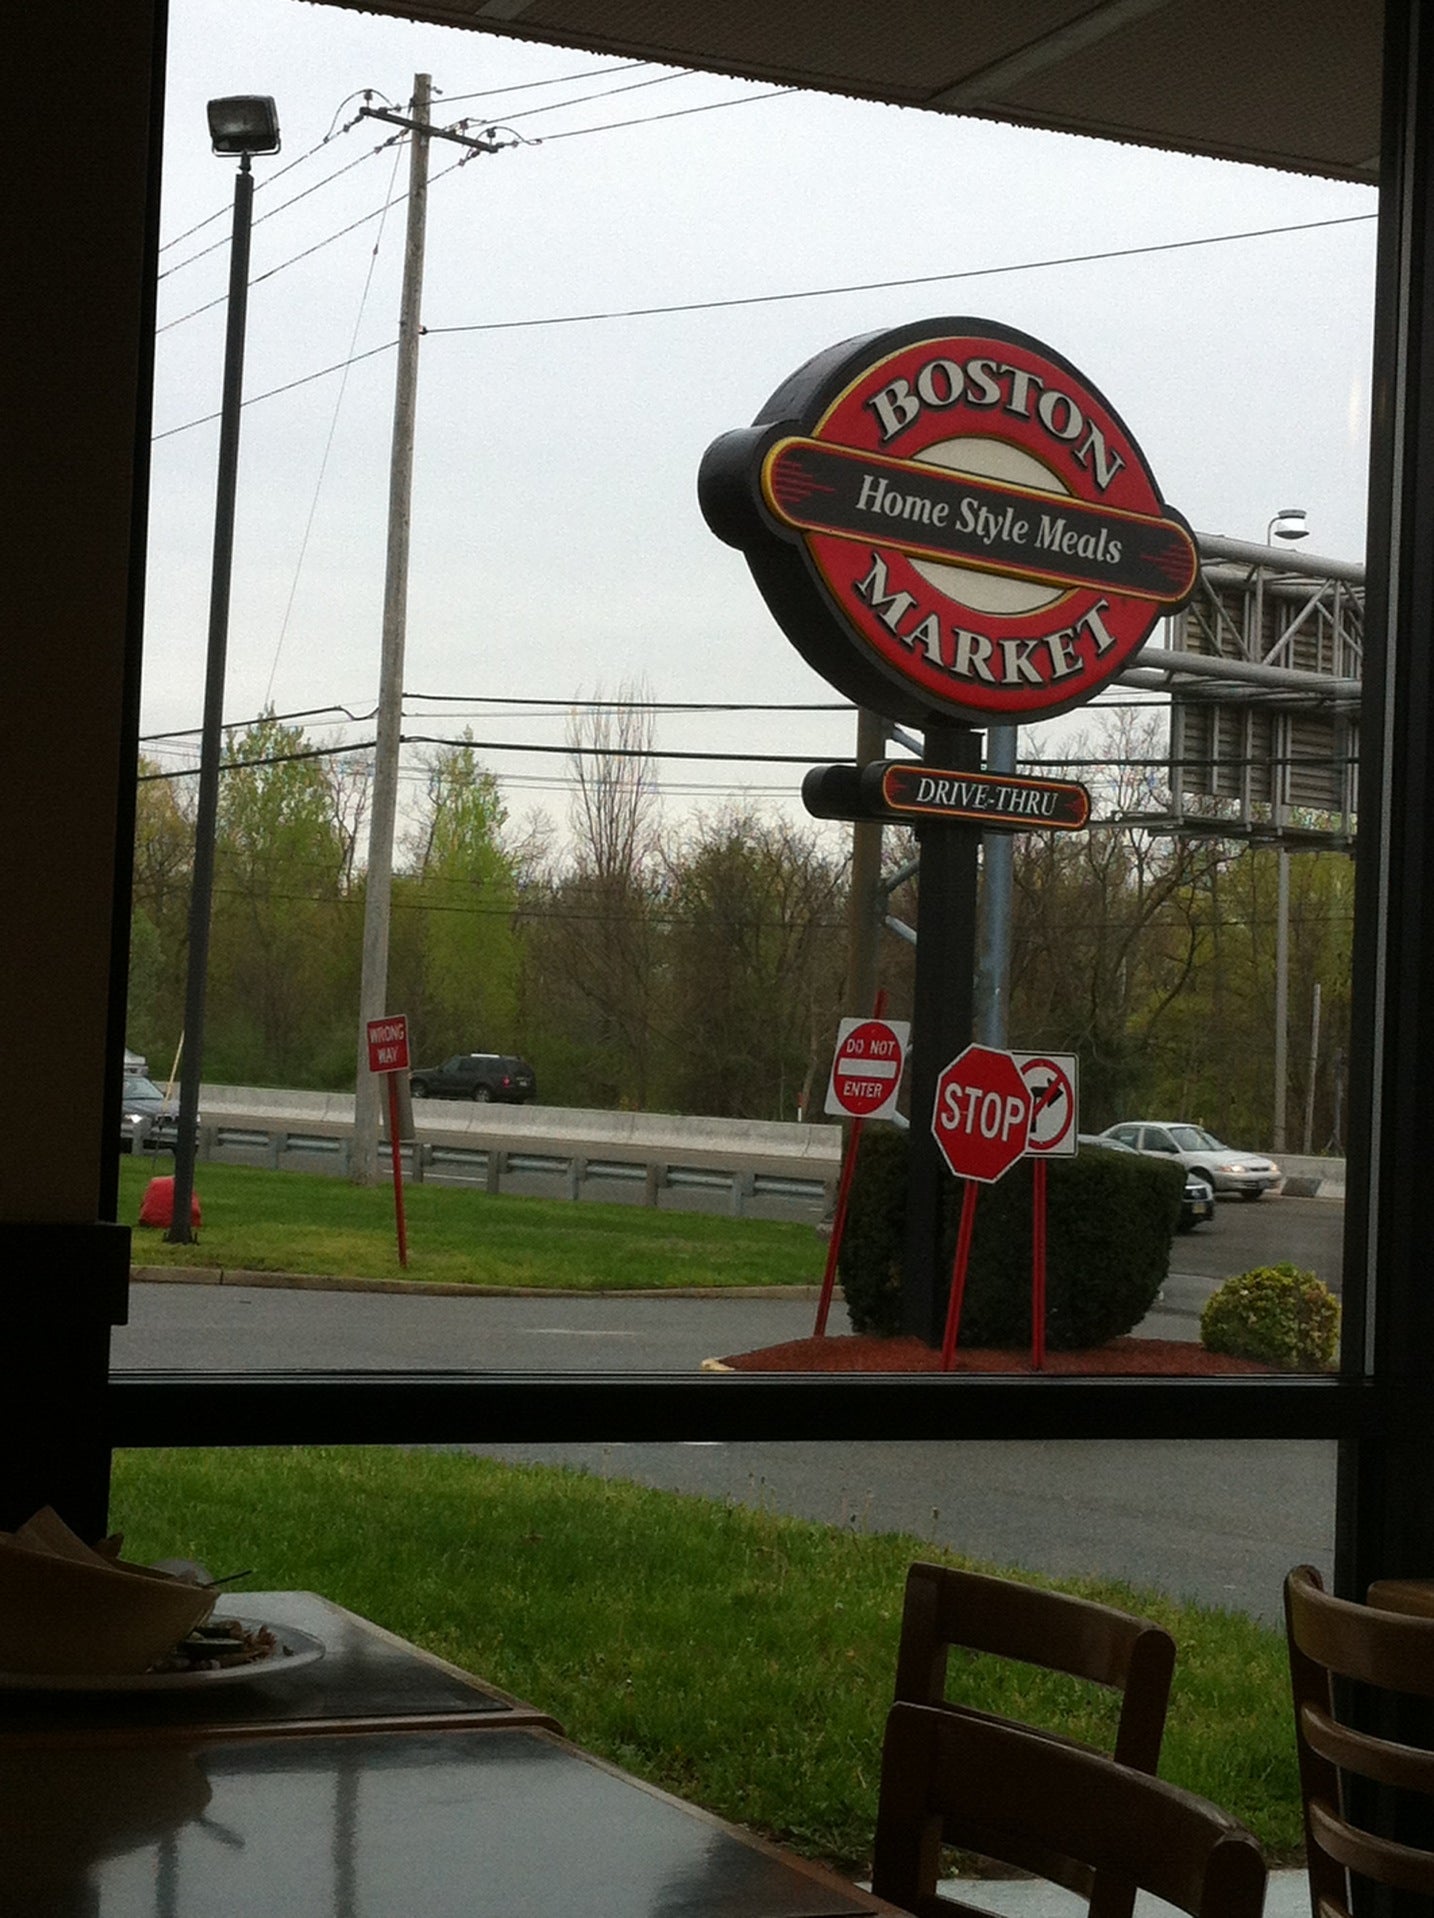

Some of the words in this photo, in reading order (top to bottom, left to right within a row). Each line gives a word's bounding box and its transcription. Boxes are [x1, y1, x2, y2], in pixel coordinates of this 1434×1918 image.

[867, 359, 1126, 491] BOSTON
[855, 475, 948, 527] Home
[954, 497, 1029, 544] Style
[1034, 515, 1122, 564] Meals
[856, 553, 1116, 685] MARKET
[916, 777, 1058, 816] DRIVE-THRU
[369, 1023, 404, 1043] WRONG
[846, 1039, 863, 1054] DO
[870, 1041, 896, 1056] NOT
[377, 1046, 399, 1064] WAY
[843, 1082, 883, 1098] ENTER
[940, 1083, 1025, 1142] STOP
